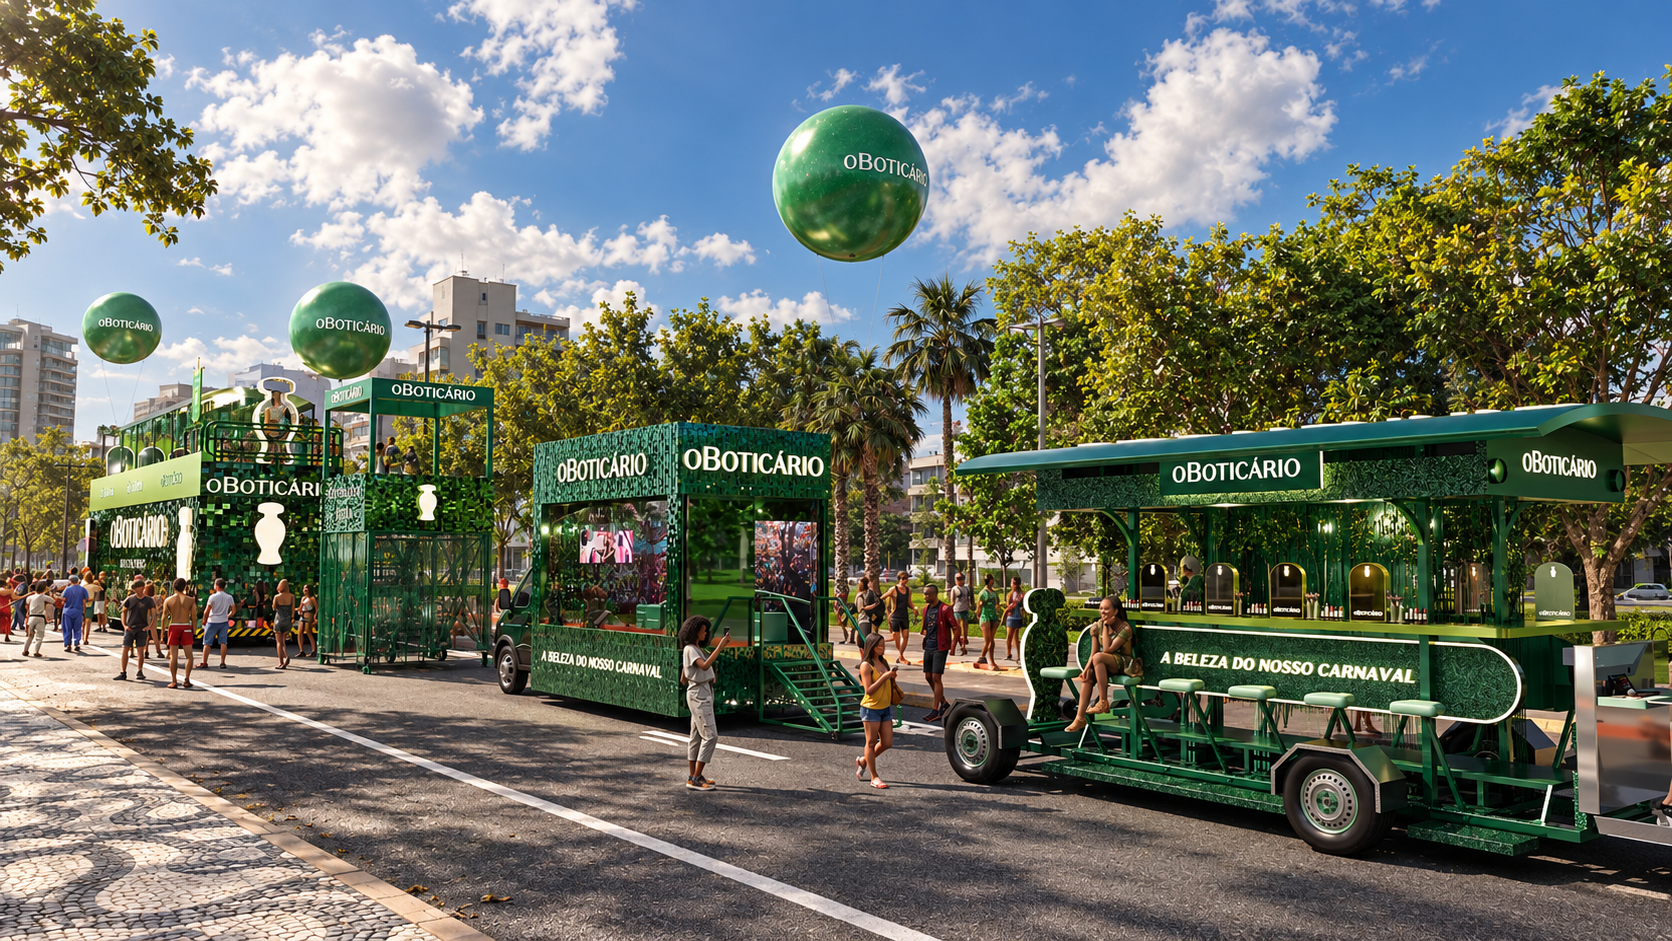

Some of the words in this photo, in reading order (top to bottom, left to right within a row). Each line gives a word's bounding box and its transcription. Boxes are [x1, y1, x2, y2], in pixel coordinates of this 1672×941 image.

[843, 152, 928, 187] oBOTICÁRIO
[98, 317, 154, 332] oBOTICÁRIO
[315, 316, 385, 336] oBOTICÁRIO
[391, 383, 476, 401] oBOTICÁRIO
[557, 451, 647, 483] oBOTICÁRIO
[683, 445, 825, 478] oBOTICÁRIO
[1172, 456, 1302, 484] oBOTICÁRIO
[1522, 449, 1598, 480] oBOTICÁRIO
[206, 476, 321, 497] oBOTICÁRI
[110, 511, 167, 549] oBOTICÁRIO
[541, 650, 547, 662] A
[575, 654, 587, 668] DO
[588, 656, 615, 672] NOSSO
[615, 660, 663, 679] CARNAVAL
[1160, 651, 1171, 664] A
[1173, 652, 1228, 669] BELEZA
[1231, 656, 1255, 671] DO
[1258, 659, 1314, 676] NOSSO
[1317, 663, 1416, 684] CARNAVAL
